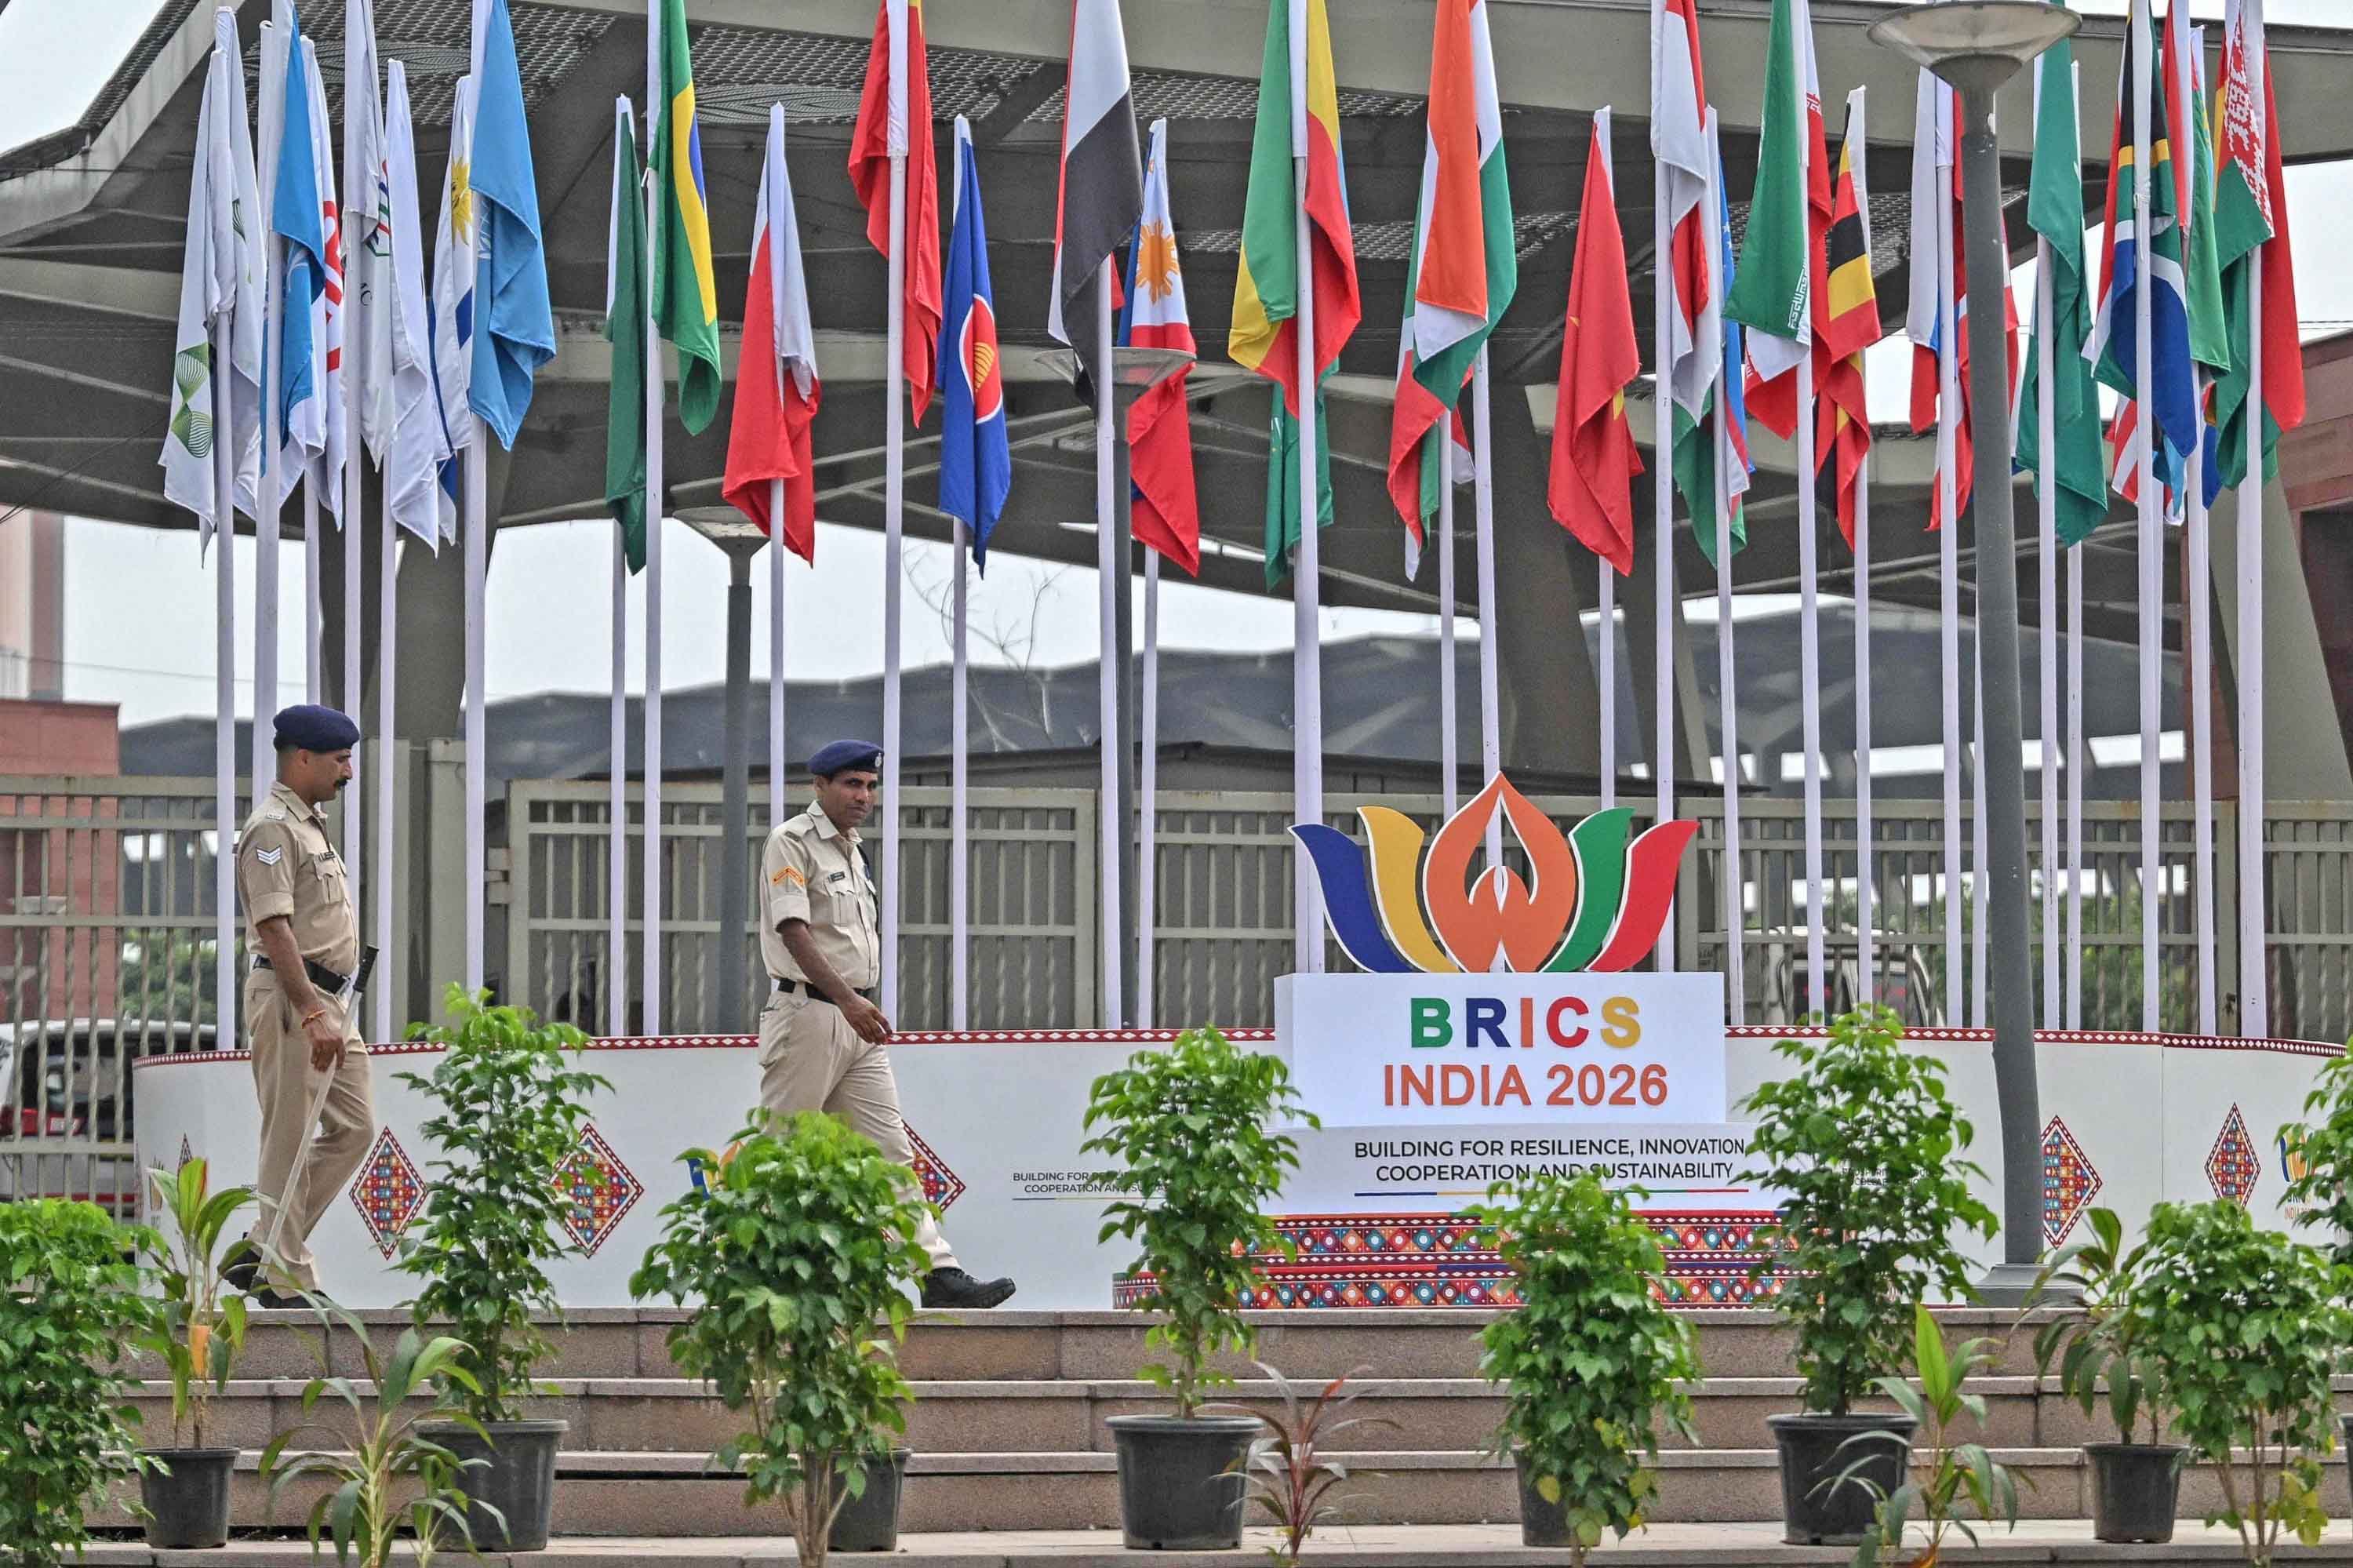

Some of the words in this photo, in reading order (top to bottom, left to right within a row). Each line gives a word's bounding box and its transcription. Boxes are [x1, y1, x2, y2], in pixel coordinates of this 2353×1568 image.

[1410, 996, 1642, 1048] BRICS
[1384, 1064, 1532, 1106] INDIA
[1546, 1064, 1667, 1106] 2026
[1355, 1141, 1453, 1158] BUILDING
[1460, 1140, 1504, 1156] FOR
[1511, 1139, 1635, 1158] RESILIENCE,
[1013, 1173, 1064, 1181] BUILDING
[1067, 1172, 1089, 1181] FOR
[1376, 1164, 1530, 1181] COOPERATION
[1024, 1184, 1102, 1193] COOPERATION
